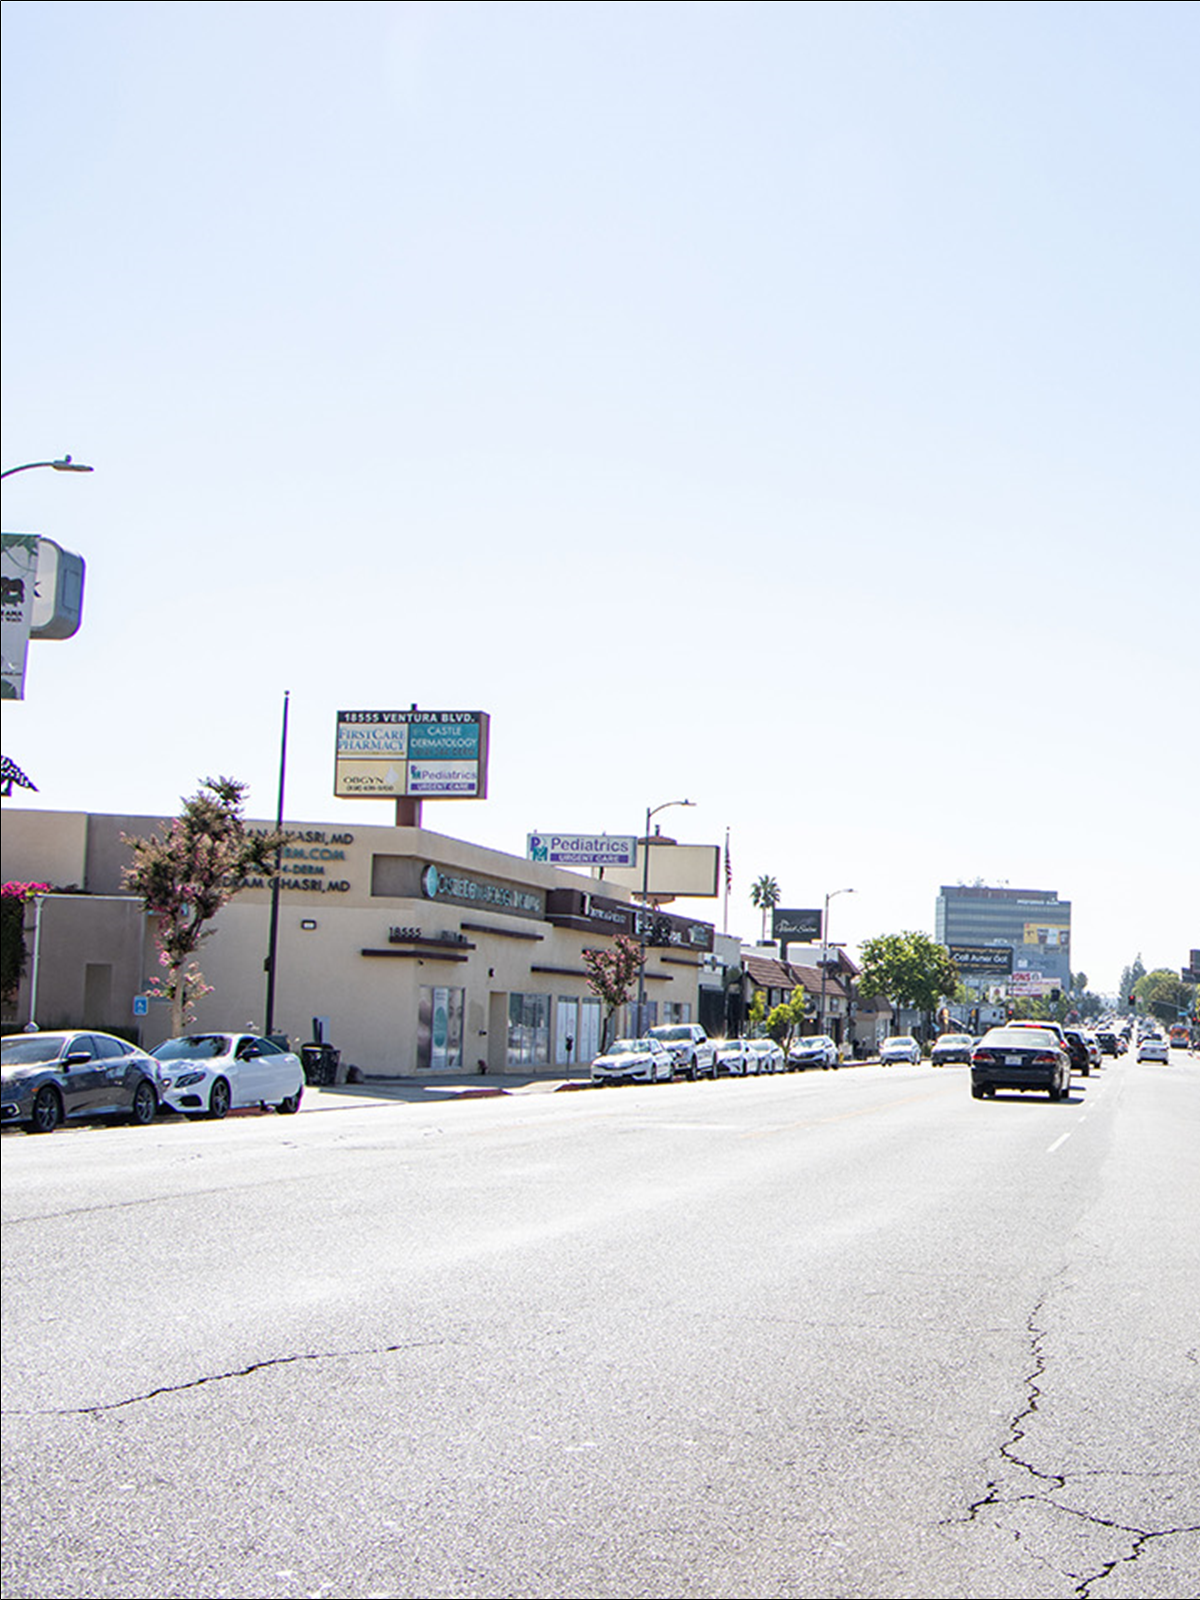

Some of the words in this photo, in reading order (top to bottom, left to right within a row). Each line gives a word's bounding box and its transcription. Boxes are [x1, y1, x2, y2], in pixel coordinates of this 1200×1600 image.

[345, 714, 379, 722] 18555
[383, 714, 439, 722] VENTURA
[441, 714, 475, 722] BLVD.
[427, 726, 462, 736] CASTLE
[338, 740, 405, 750] PHARMACY
[411, 738, 477, 748] DERMATOLOGY
[343, 776, 384, 784] OBGYN
[422, 770, 476, 780] Pediatrics
[551, 837, 629, 852] Pediatrics
[558, 854, 594, 862] URGENT
[389, 926, 421, 938] 18555
